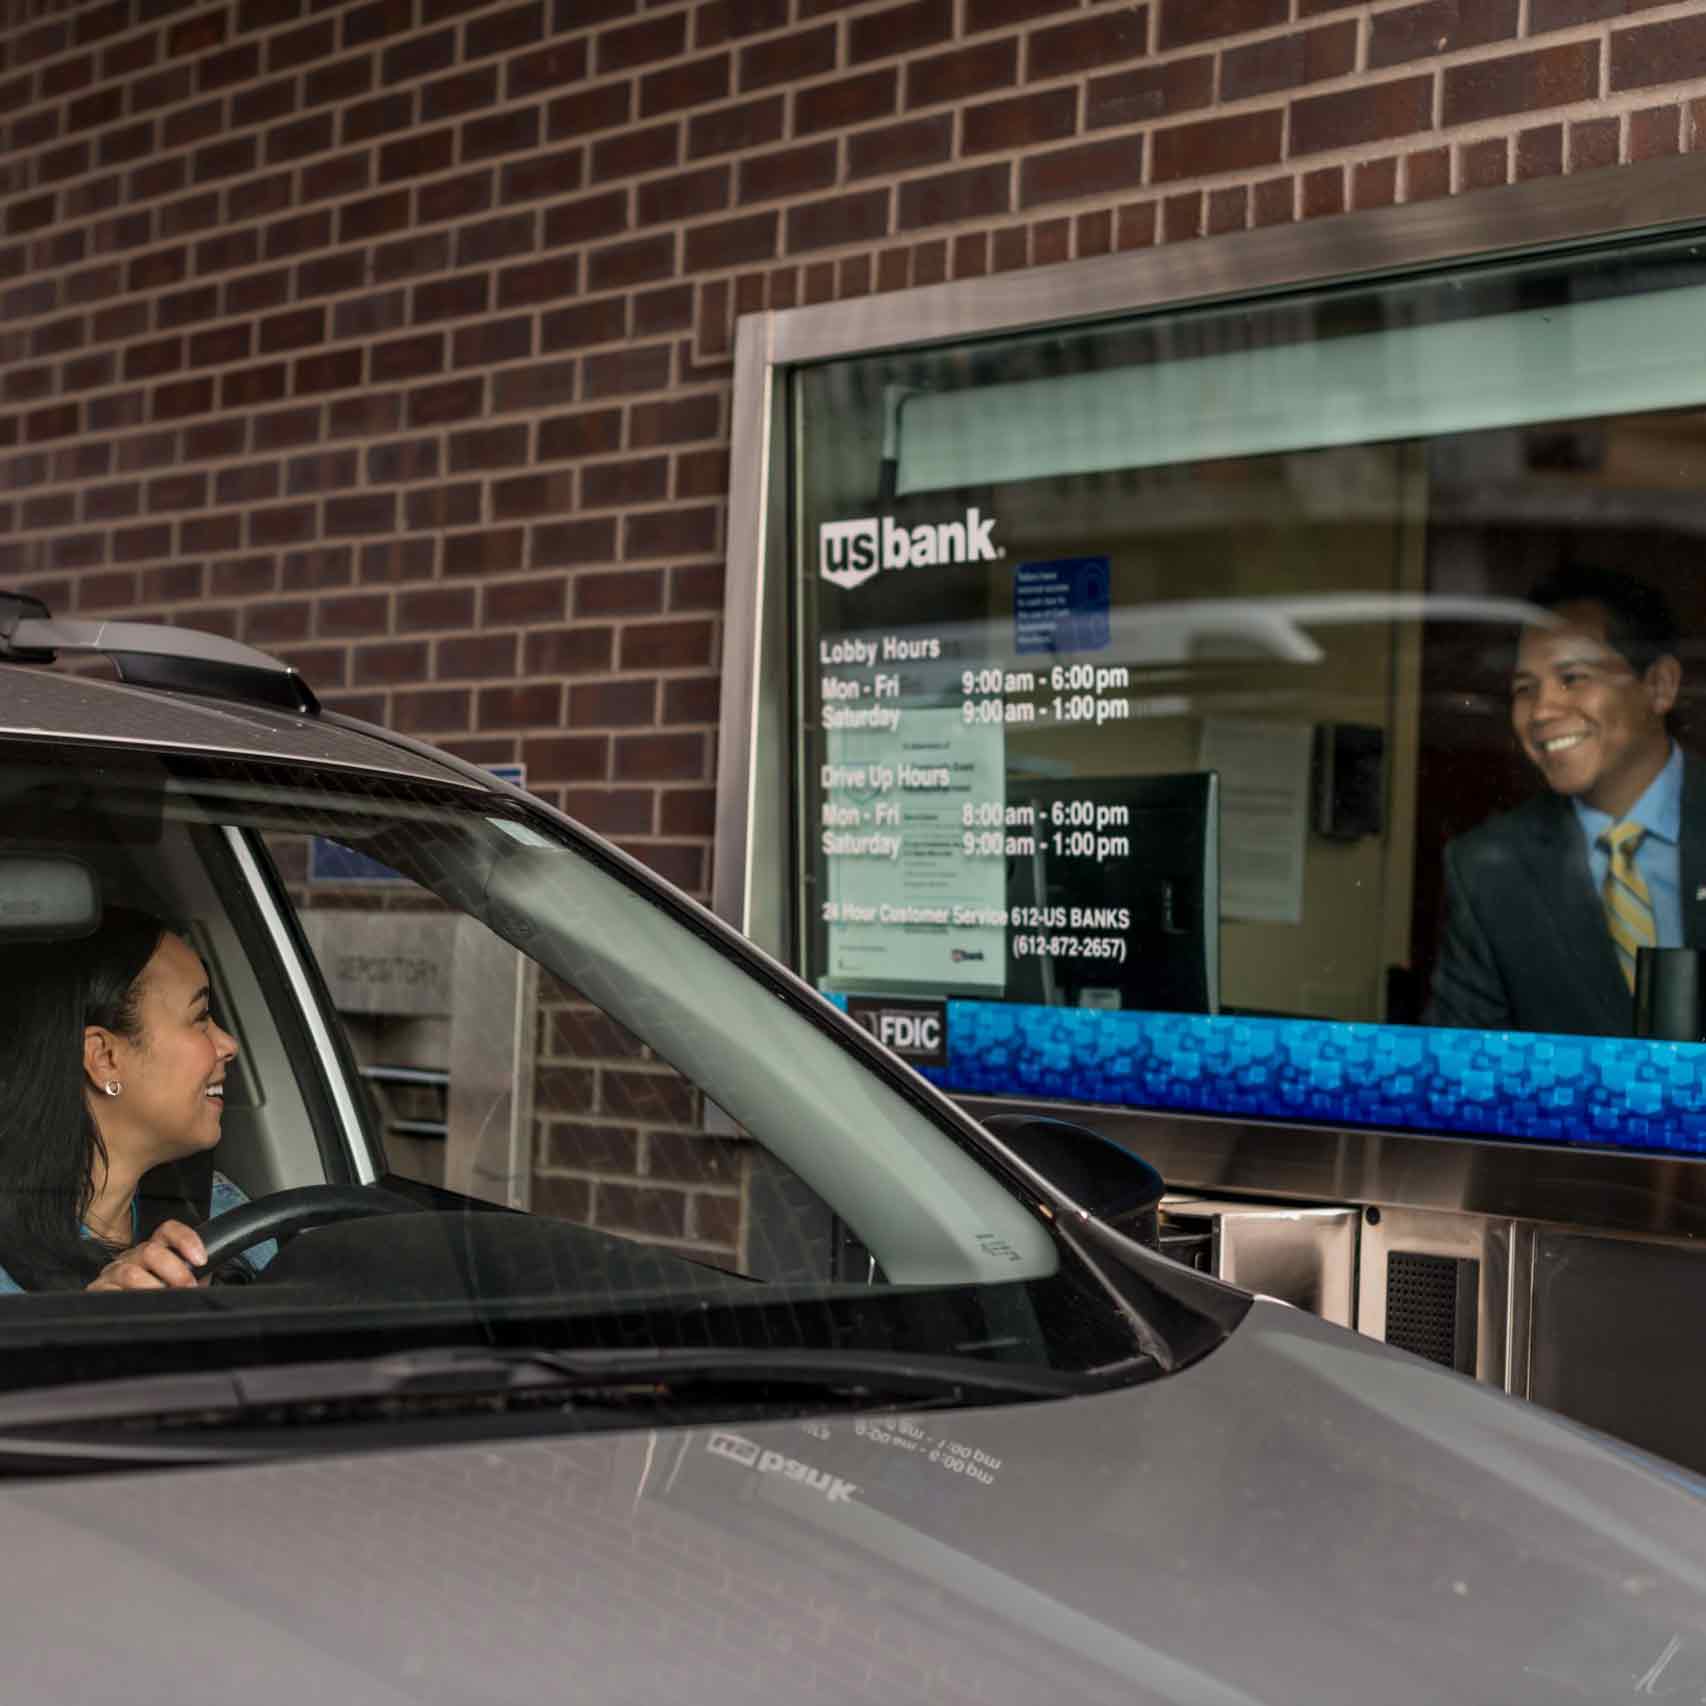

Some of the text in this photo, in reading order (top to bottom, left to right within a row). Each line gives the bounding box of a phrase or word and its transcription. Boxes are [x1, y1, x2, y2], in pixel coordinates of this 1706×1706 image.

[820, 636, 941, 667] Lobby Hours
[821, 676, 859, 699] Mon
[875, 672, 899, 698] Fri
[821, 704, 901, 732] Saturday
[821, 764, 865, 788] Drive
[868, 764, 893, 793] Up
[896, 763, 950, 787] Hours
[821, 802, 860, 826] Mon
[875, 801, 901, 825] Fri
[821, 831, 901, 860] Saturday
[879, 903, 949, 923] Customer
[952, 905, 1008, 926] Service
[1011, 906, 1067, 928] 612-US
[1070, 906, 1131, 930] BANKS
[1013, 934, 1127, 963] (612-872-2657)
[880, 1015, 941, 1049] FDIC
